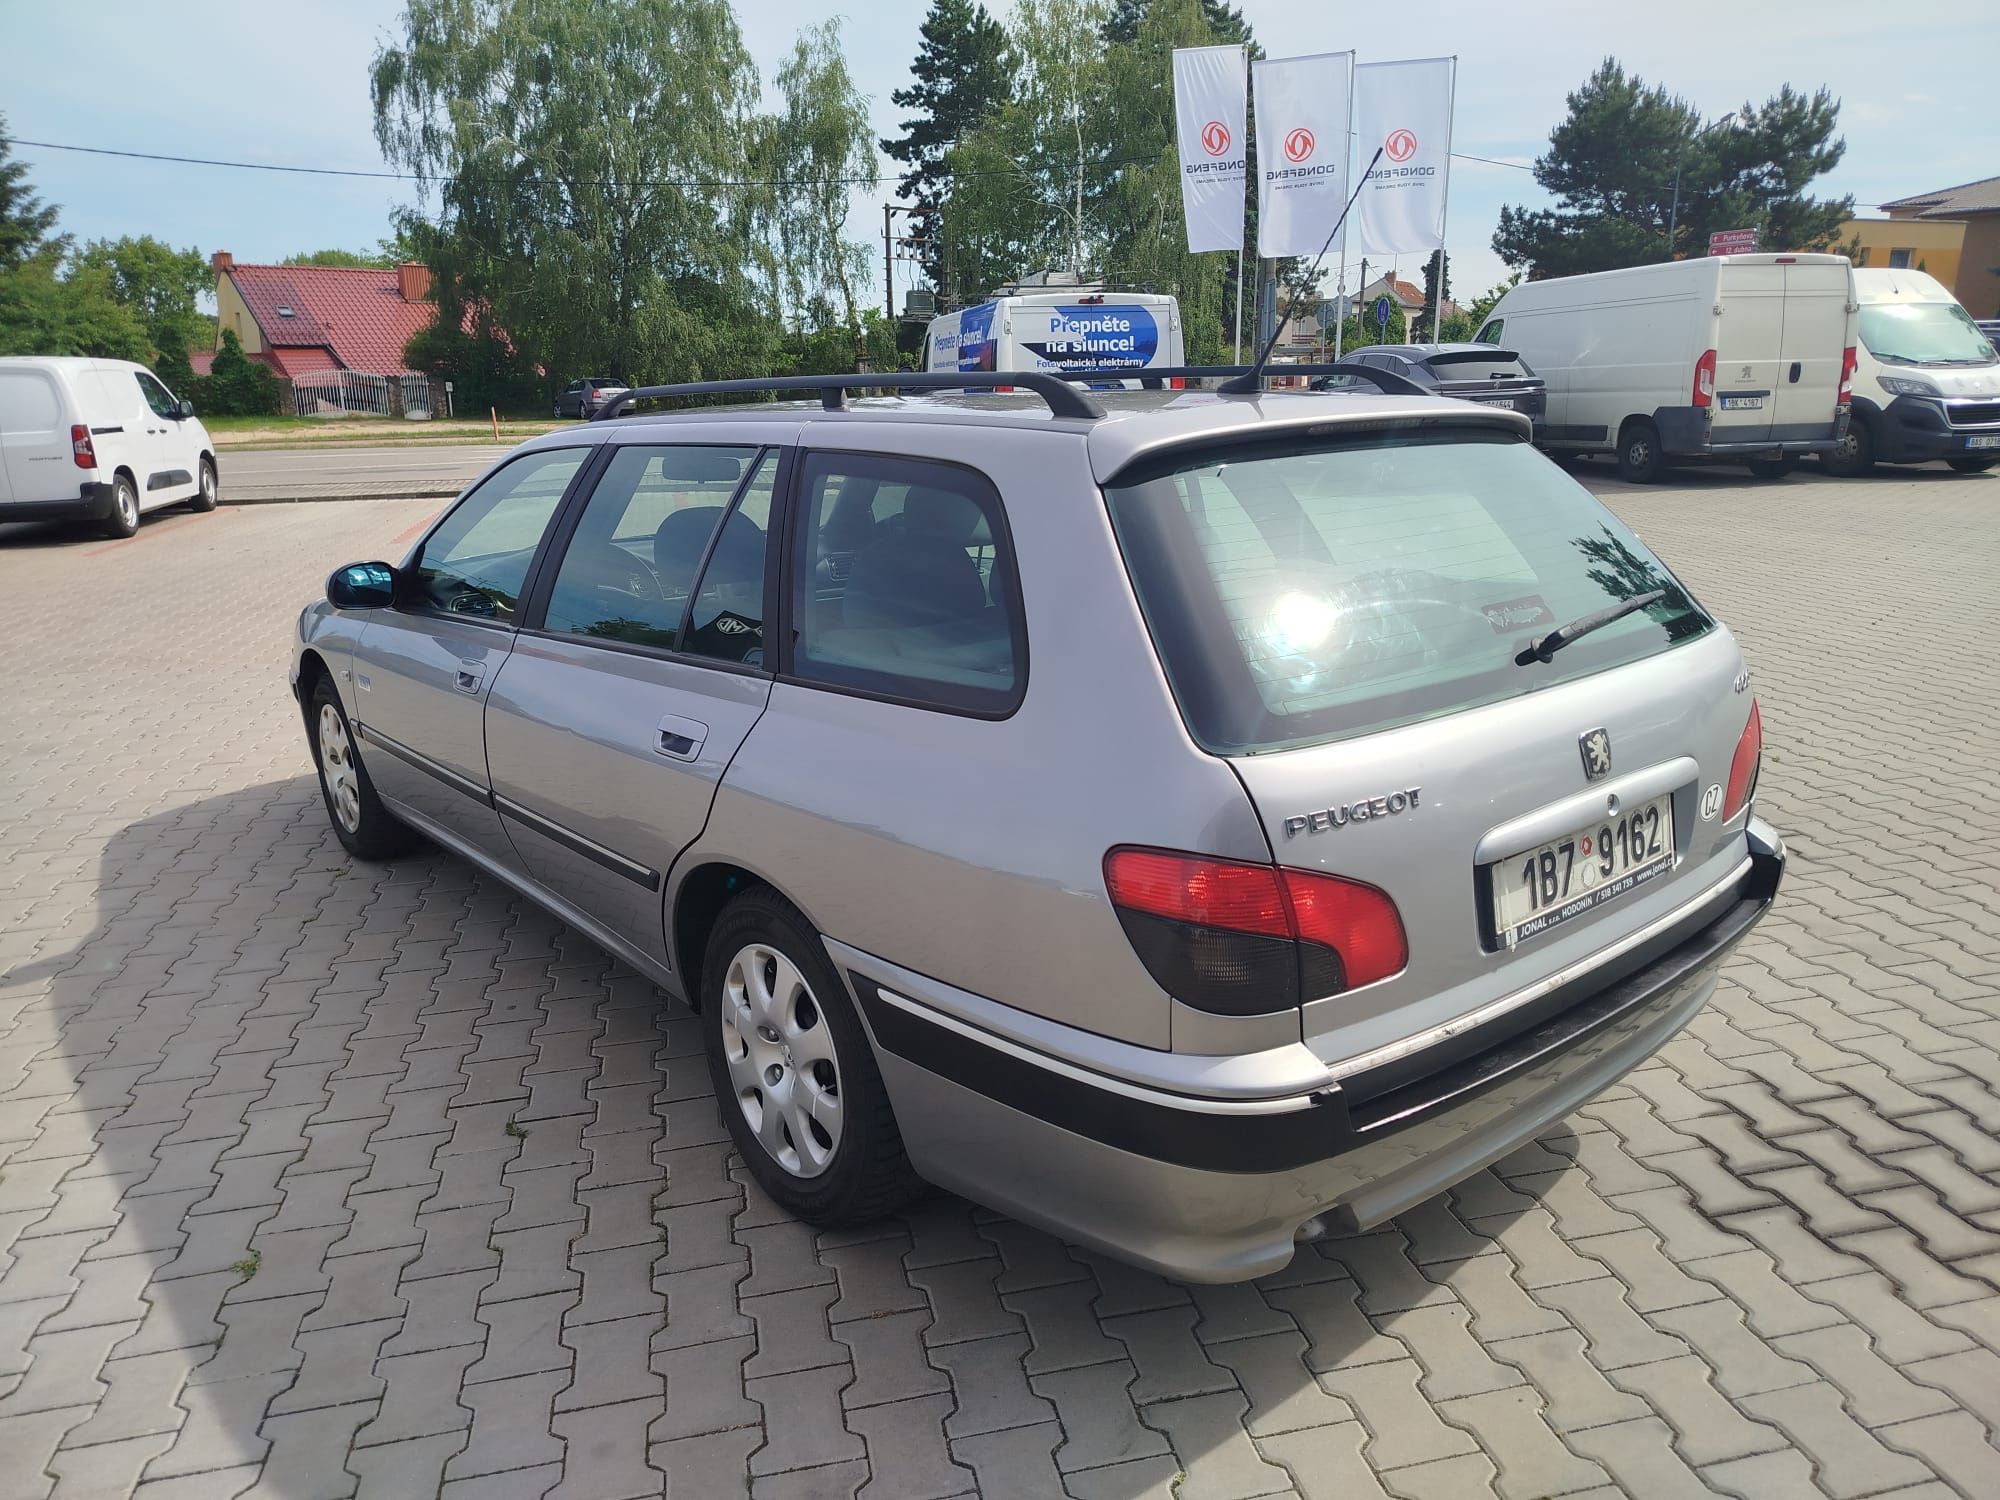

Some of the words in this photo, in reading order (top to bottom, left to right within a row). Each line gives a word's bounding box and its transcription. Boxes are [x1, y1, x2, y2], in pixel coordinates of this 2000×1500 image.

[1050, 315, 1130, 336] Přepněte
[1046, 341, 1068, 353] na
[1073, 335, 1135, 352] slunce!
[1036, 358, 1097, 368] Fotovoltaické
[1098, 357, 1144, 368] elektrárny
[1285, 786, 1423, 838] PEUGEOT
[1705, 787, 1719, 816] CZ
[1523, 842, 1575, 910] 1B7
[1599, 806, 1661, 876] 9162
[1520, 920, 1547, 937] JONAL
[1561, 896, 1593, 919] HODONÍN
[1600, 888, 1612, 900] 518
[1612, 882, 1622, 895] 341
[1622, 876, 1634, 889] 739
